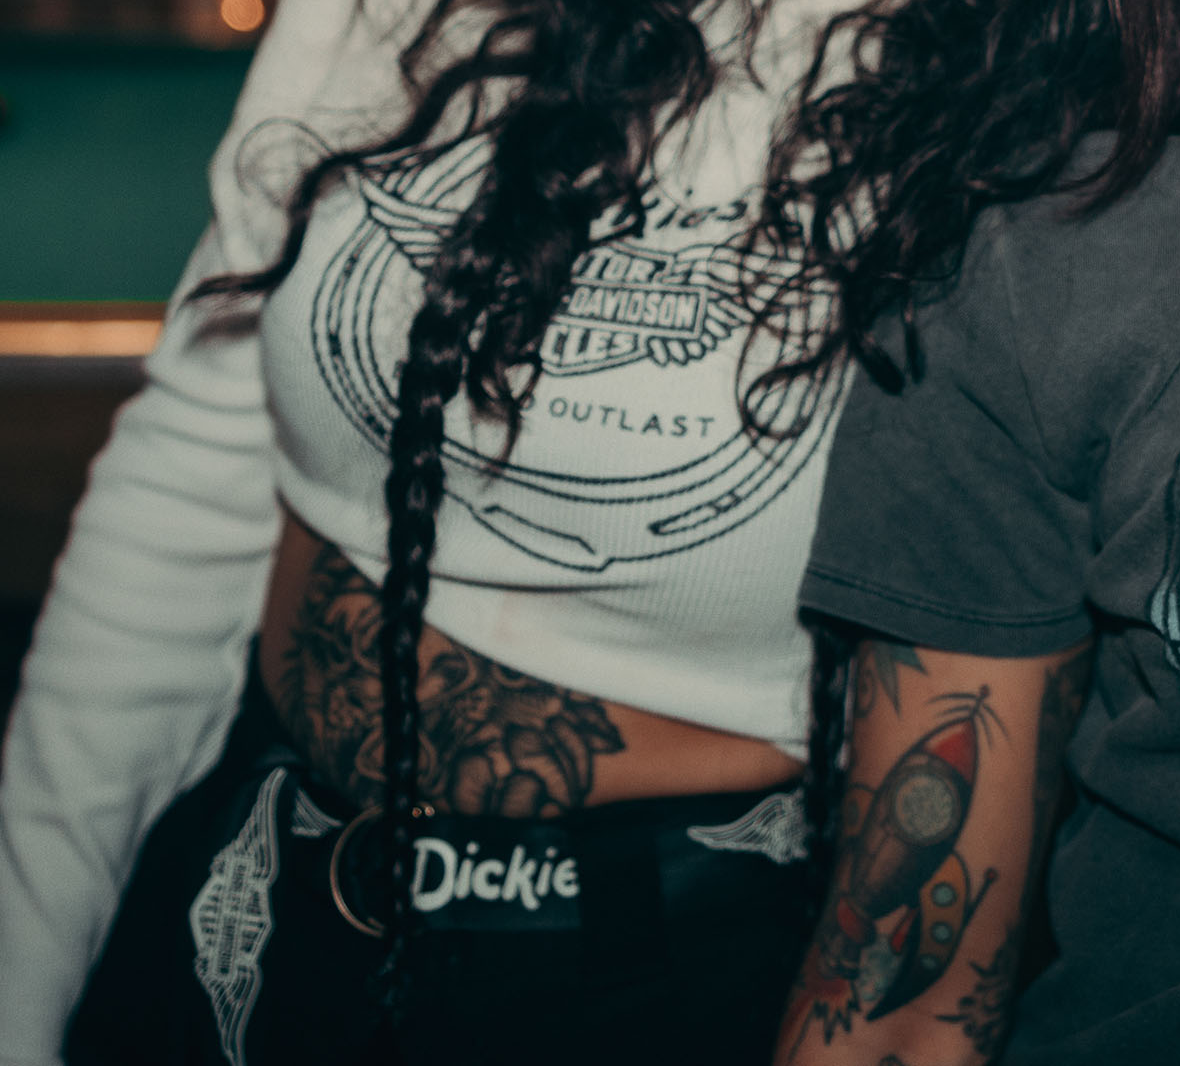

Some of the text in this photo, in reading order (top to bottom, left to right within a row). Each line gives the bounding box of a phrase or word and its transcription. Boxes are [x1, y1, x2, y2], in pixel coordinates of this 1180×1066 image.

[572, 247, 656, 282] TOR
[541, 323, 636, 366] CLES
[549, 397, 715, 437] OUTLAST
[411, 836, 580, 912] Dickie
